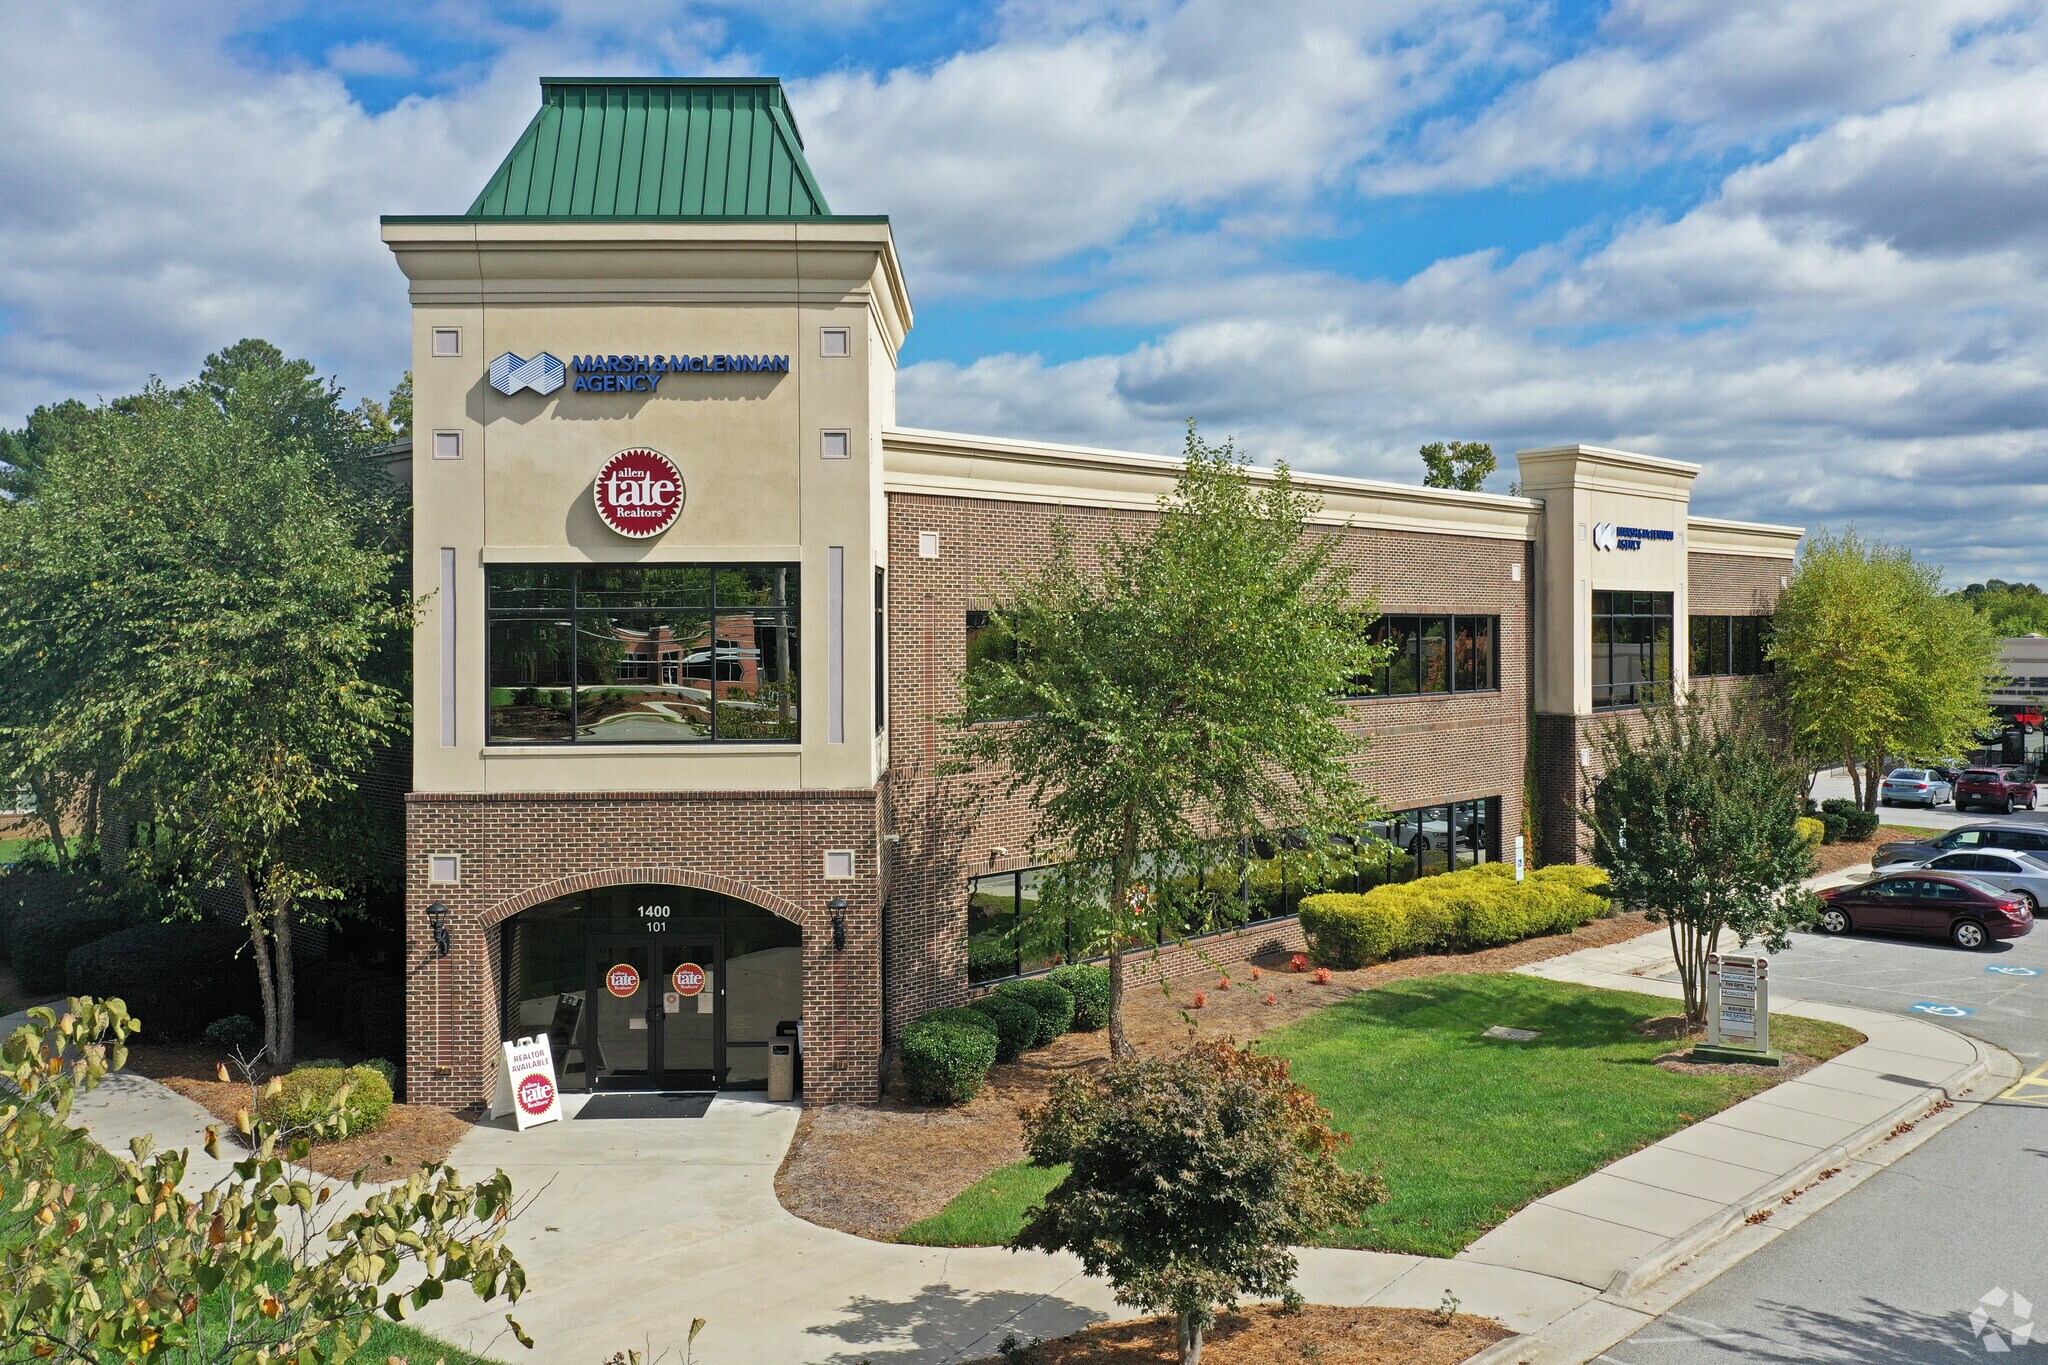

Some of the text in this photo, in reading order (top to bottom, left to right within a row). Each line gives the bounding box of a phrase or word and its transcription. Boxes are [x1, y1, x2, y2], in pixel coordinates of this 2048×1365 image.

[573, 355, 790, 373] MARSH & McLENNAN
[572, 374, 662, 392] AGENCY
[618, 467, 645, 478] allen
[604, 470, 676, 506] tate
[637, 905, 671, 918] 1400
[646, 921, 666, 932] 101
[610, 971, 637, 986] tate
[676, 970, 703, 985] tate
[514, 1050, 545, 1062] REALTOR
[512, 1058, 550, 1072] AVAILABLE
[520, 1081, 553, 1104] tate
